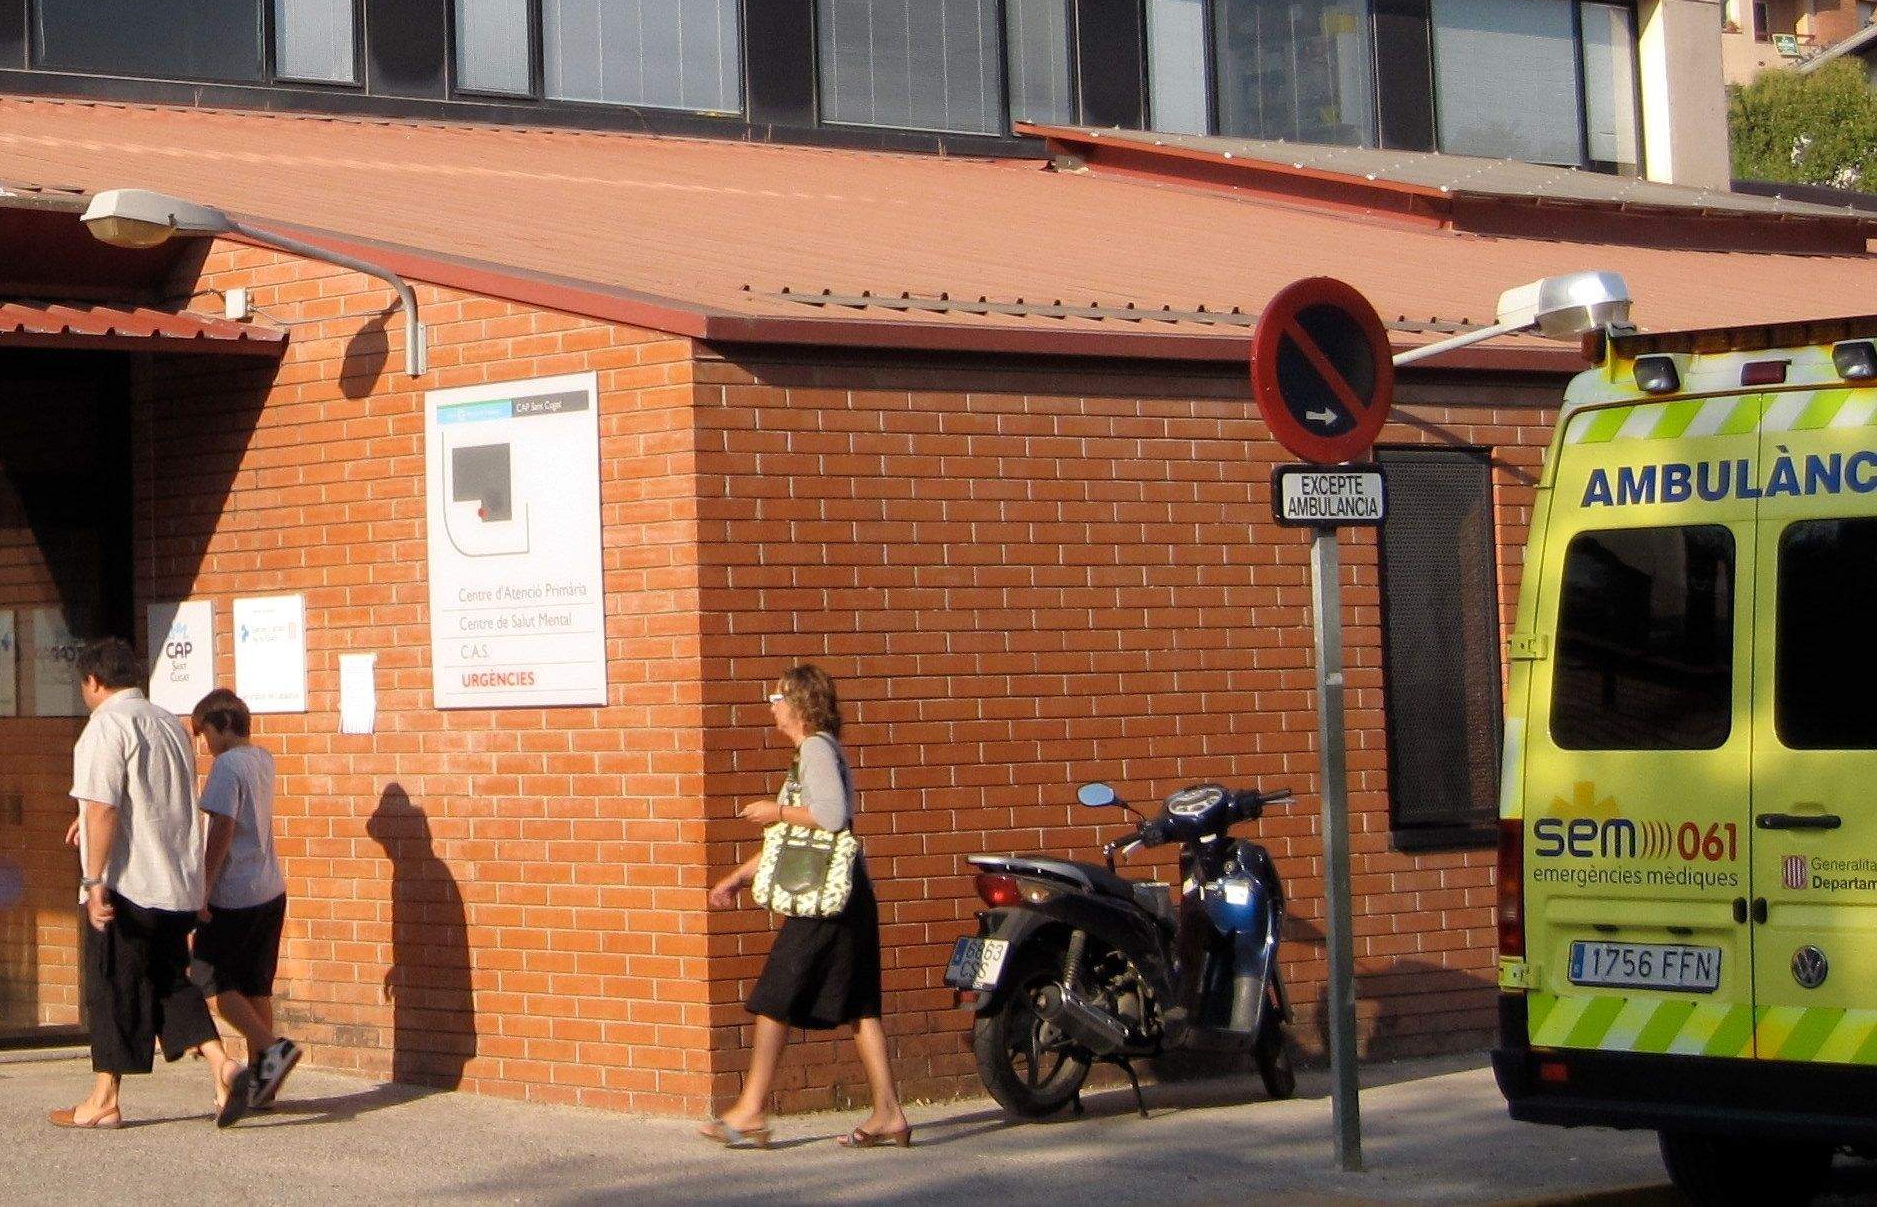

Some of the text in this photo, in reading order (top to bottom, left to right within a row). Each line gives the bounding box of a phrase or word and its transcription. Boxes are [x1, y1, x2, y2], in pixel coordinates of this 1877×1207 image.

[1301, 475, 1364, 495] EXCEPTE
[1287, 496, 1379, 517] AMBULANCIA
[458, 587, 493, 603] Centre
[459, 616, 494, 631] Centre
[497, 616, 509, 629] de
[538, 612, 572, 627] Mental
[165, 641, 193, 660] CAP
[461, 669, 535, 687] URGÈNCIES
[1677, 821, 1737, 862] 061
[1533, 862, 1739, 890] emergències mèdiques
[1592, 948, 1711, 981] 1756 FFN
